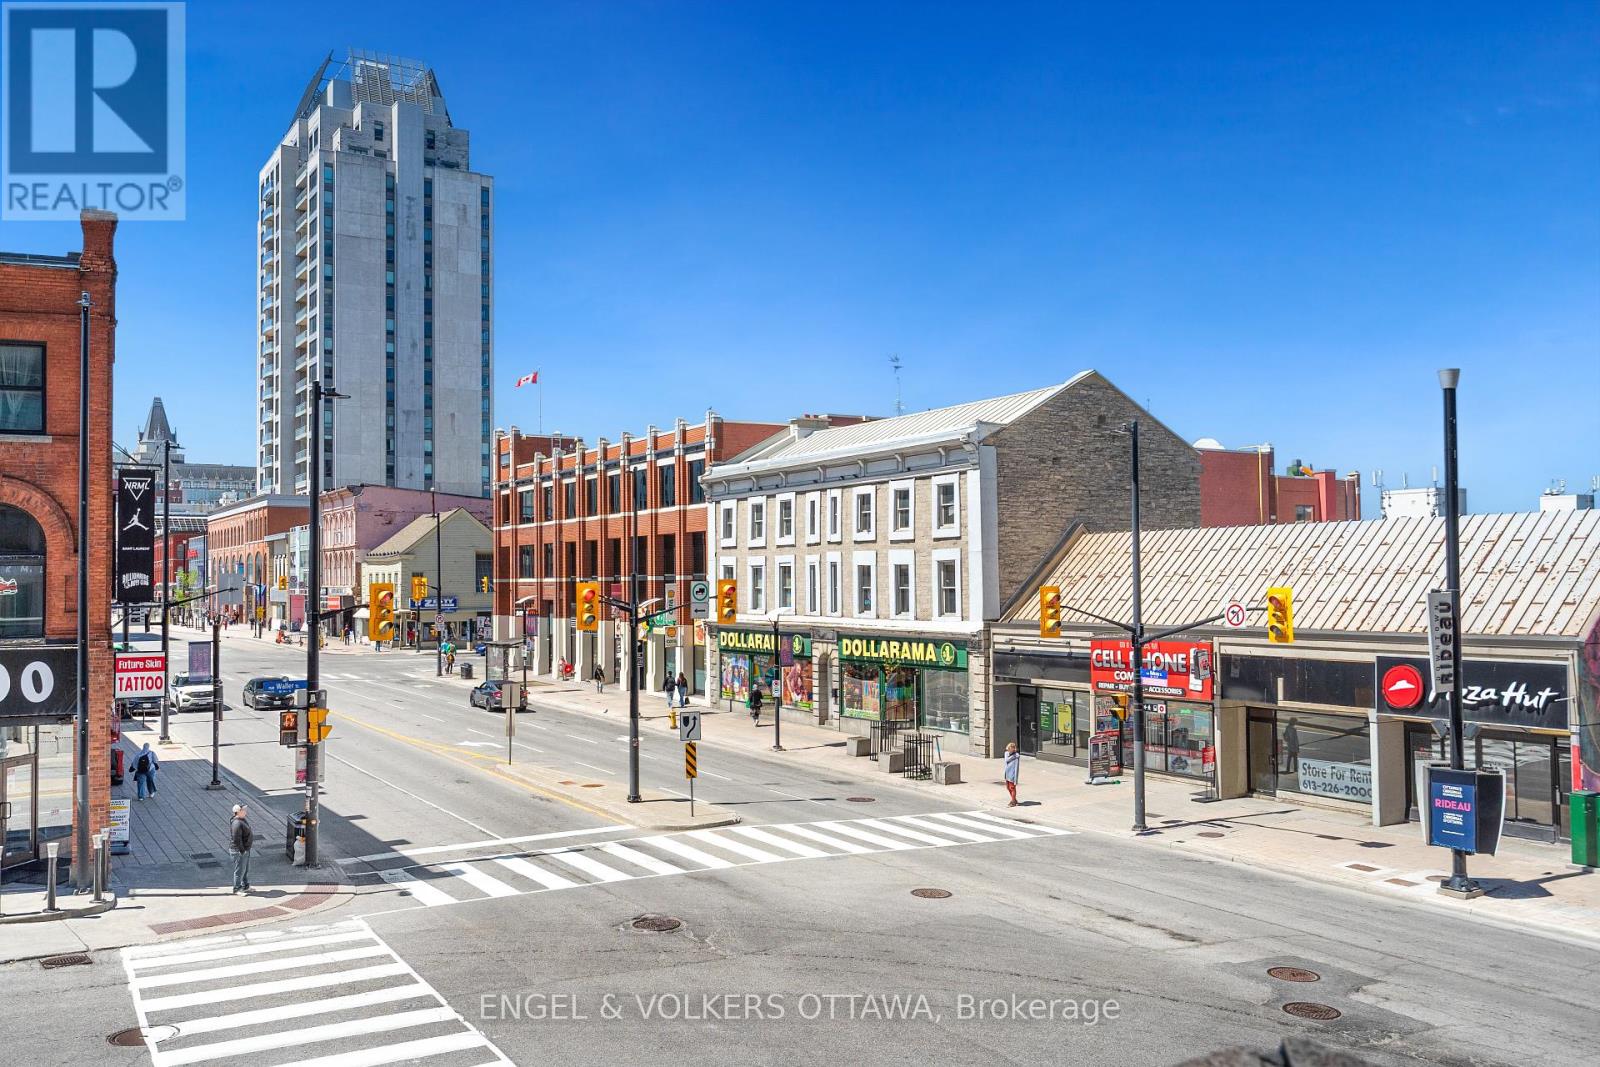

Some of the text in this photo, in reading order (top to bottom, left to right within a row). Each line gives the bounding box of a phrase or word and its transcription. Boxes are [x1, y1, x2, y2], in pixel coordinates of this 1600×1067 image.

[720, 631, 780, 651] DOLLARA
[842, 638, 937, 662] DOLLARAMA
[118, 659, 162, 669] Future Skin
[1092, 649, 1126, 669] CELL
[118, 675, 163, 692] TATTOO
[276, 682, 294, 690] Waller
[1500, 681, 1560, 708] Hut
[1302, 762, 1372, 785] Store For Rent
[1434, 798, 1472, 812] RIDEAU
